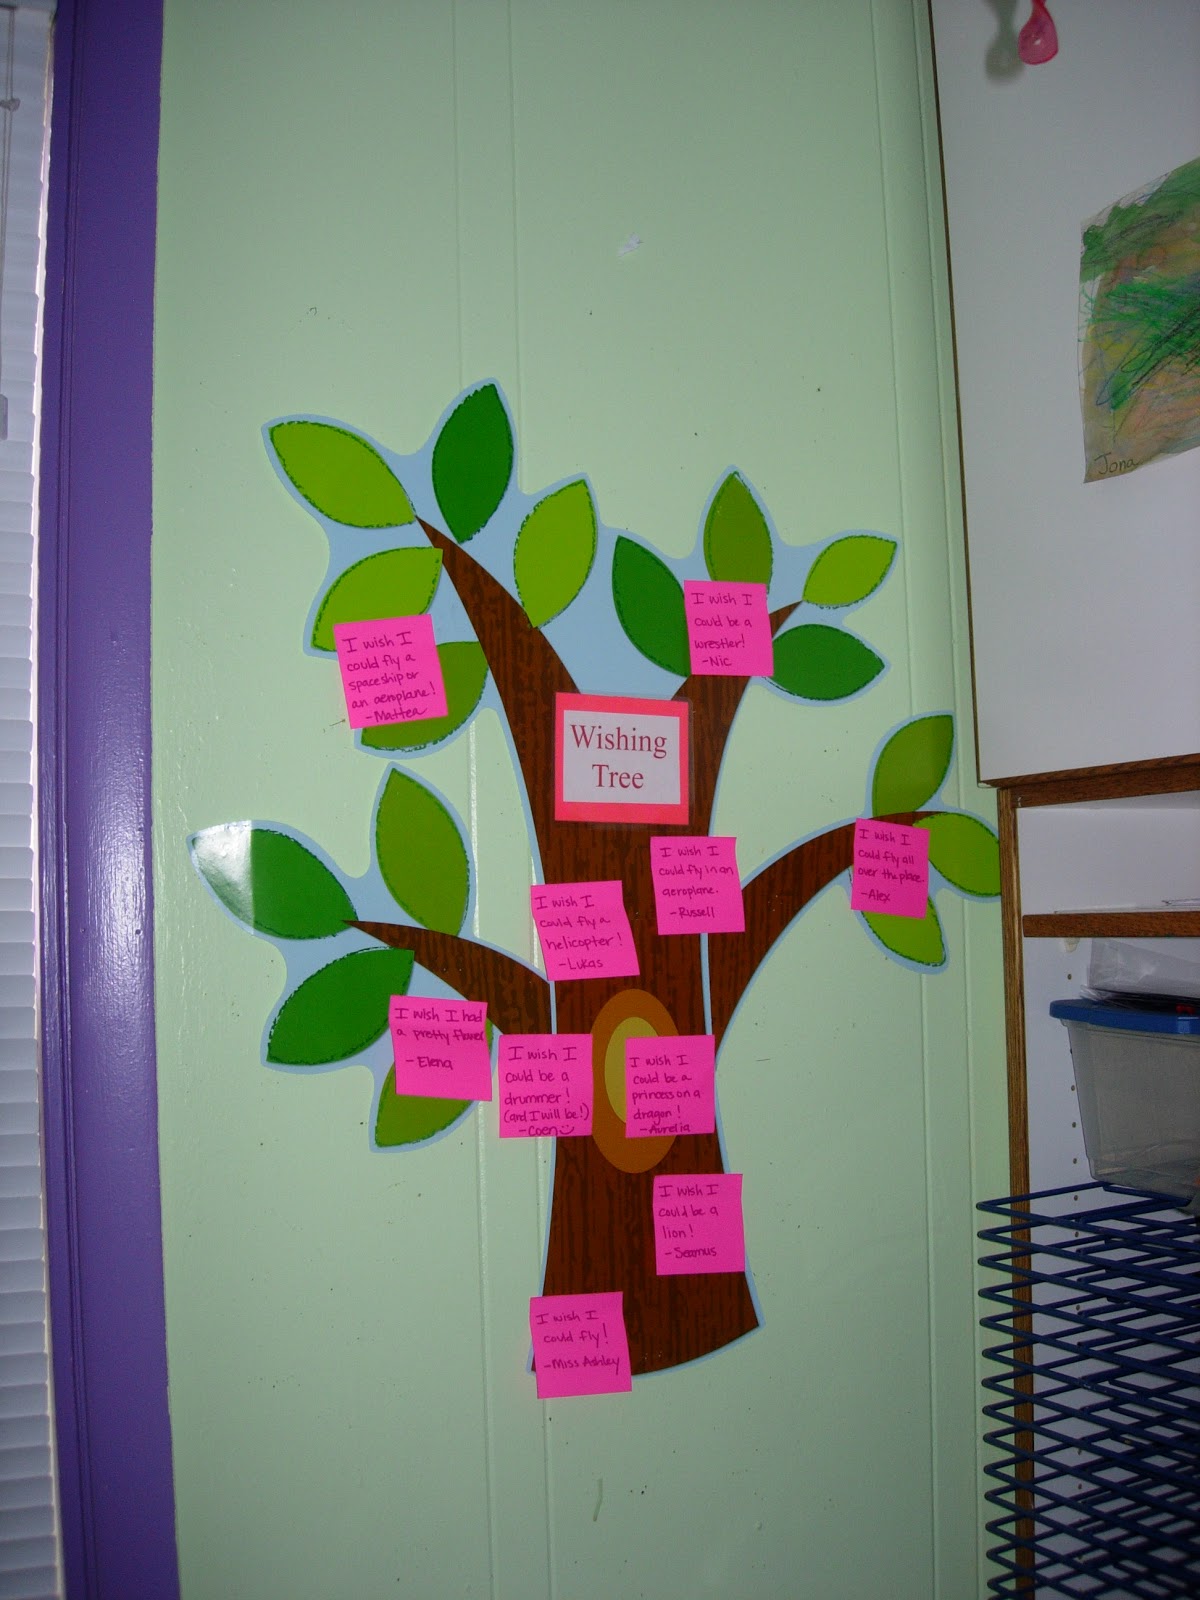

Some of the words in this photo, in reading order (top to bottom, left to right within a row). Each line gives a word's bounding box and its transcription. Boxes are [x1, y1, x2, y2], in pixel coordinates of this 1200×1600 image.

[691, 593, 704, 604] I
[709, 593, 737, 605] wish
[742, 594, 752, 605] I
[726, 616, 740, 627] be
[744, 619, 752, 627] a
[342, 637, 357, 653] I
[363, 635, 395, 649] wish
[396, 631, 412, 646] I
[694, 634, 745, 648] wrestler!
[347, 656, 379, 672] could
[382, 655, 401, 670] fly
[405, 654, 416, 662] a
[352, 700, 368, 709] an
[570, 724, 667, 759] Wishing
[591, 764, 644, 789] Tree
[859, 828, 869, 839] I
[874, 832, 895, 843] wish
[901, 834, 911, 846] I
[660, 847, 671, 857] I
[678, 845, 702, 856] wish
[707, 846, 720, 856] I
[883, 851, 900, 868] fly
[902, 856, 914, 865] all
[687, 864, 703, 880] fly
[705, 865, 717, 874] in
[720, 866, 734, 875] an
[858, 868, 878, 877] over
[882, 869, 898, 880] the
[534, 896, 548, 910] I
[552, 895, 578, 908] wish
[580, 895, 595, 908] I
[540, 916, 573, 928] could
[577, 915, 596, 930] fly
[395, 1008, 409, 1019] I
[413, 1007, 440, 1022] wish
[445, 1009, 459, 1022] I
[462, 1009, 483, 1022] had
[397, 1028, 407, 1036] a
[413, 1029, 450, 1046] pretty
[452, 1029, 485, 1041] flower
[508, 1046, 524, 1061] I
[528, 1048, 558, 1060] wish
[562, 1046, 577, 1061] I
[629, 1056, 640, 1068] I
[645, 1055, 671, 1066] wish
[676, 1054, 689, 1066] I
[538, 1070, 555, 1082] be
[561, 1071, 570, 1082] a
[633, 1071, 660, 1085] could
[664, 1072, 678, 1083] be
[632, 1090, 675, 1105] princess
[693, 1089, 701, 1099] a
[504, 1109, 528, 1123] (and
[529, 1110, 540, 1121] I
[541, 1108, 560, 1120] will
[658, 1184, 673, 1197] I
[677, 1184, 703, 1197] wish
[706, 1184, 719, 1195] I
[690, 1204, 705, 1216] be
[709, 1206, 719, 1216] a
[535, 1313, 549, 1325] I
[553, 1311, 580, 1322] wish
[584, 1310, 599, 1320] I
[543, 1330, 574, 1343] could
[582, 1354, 620, 1375] Ashley
